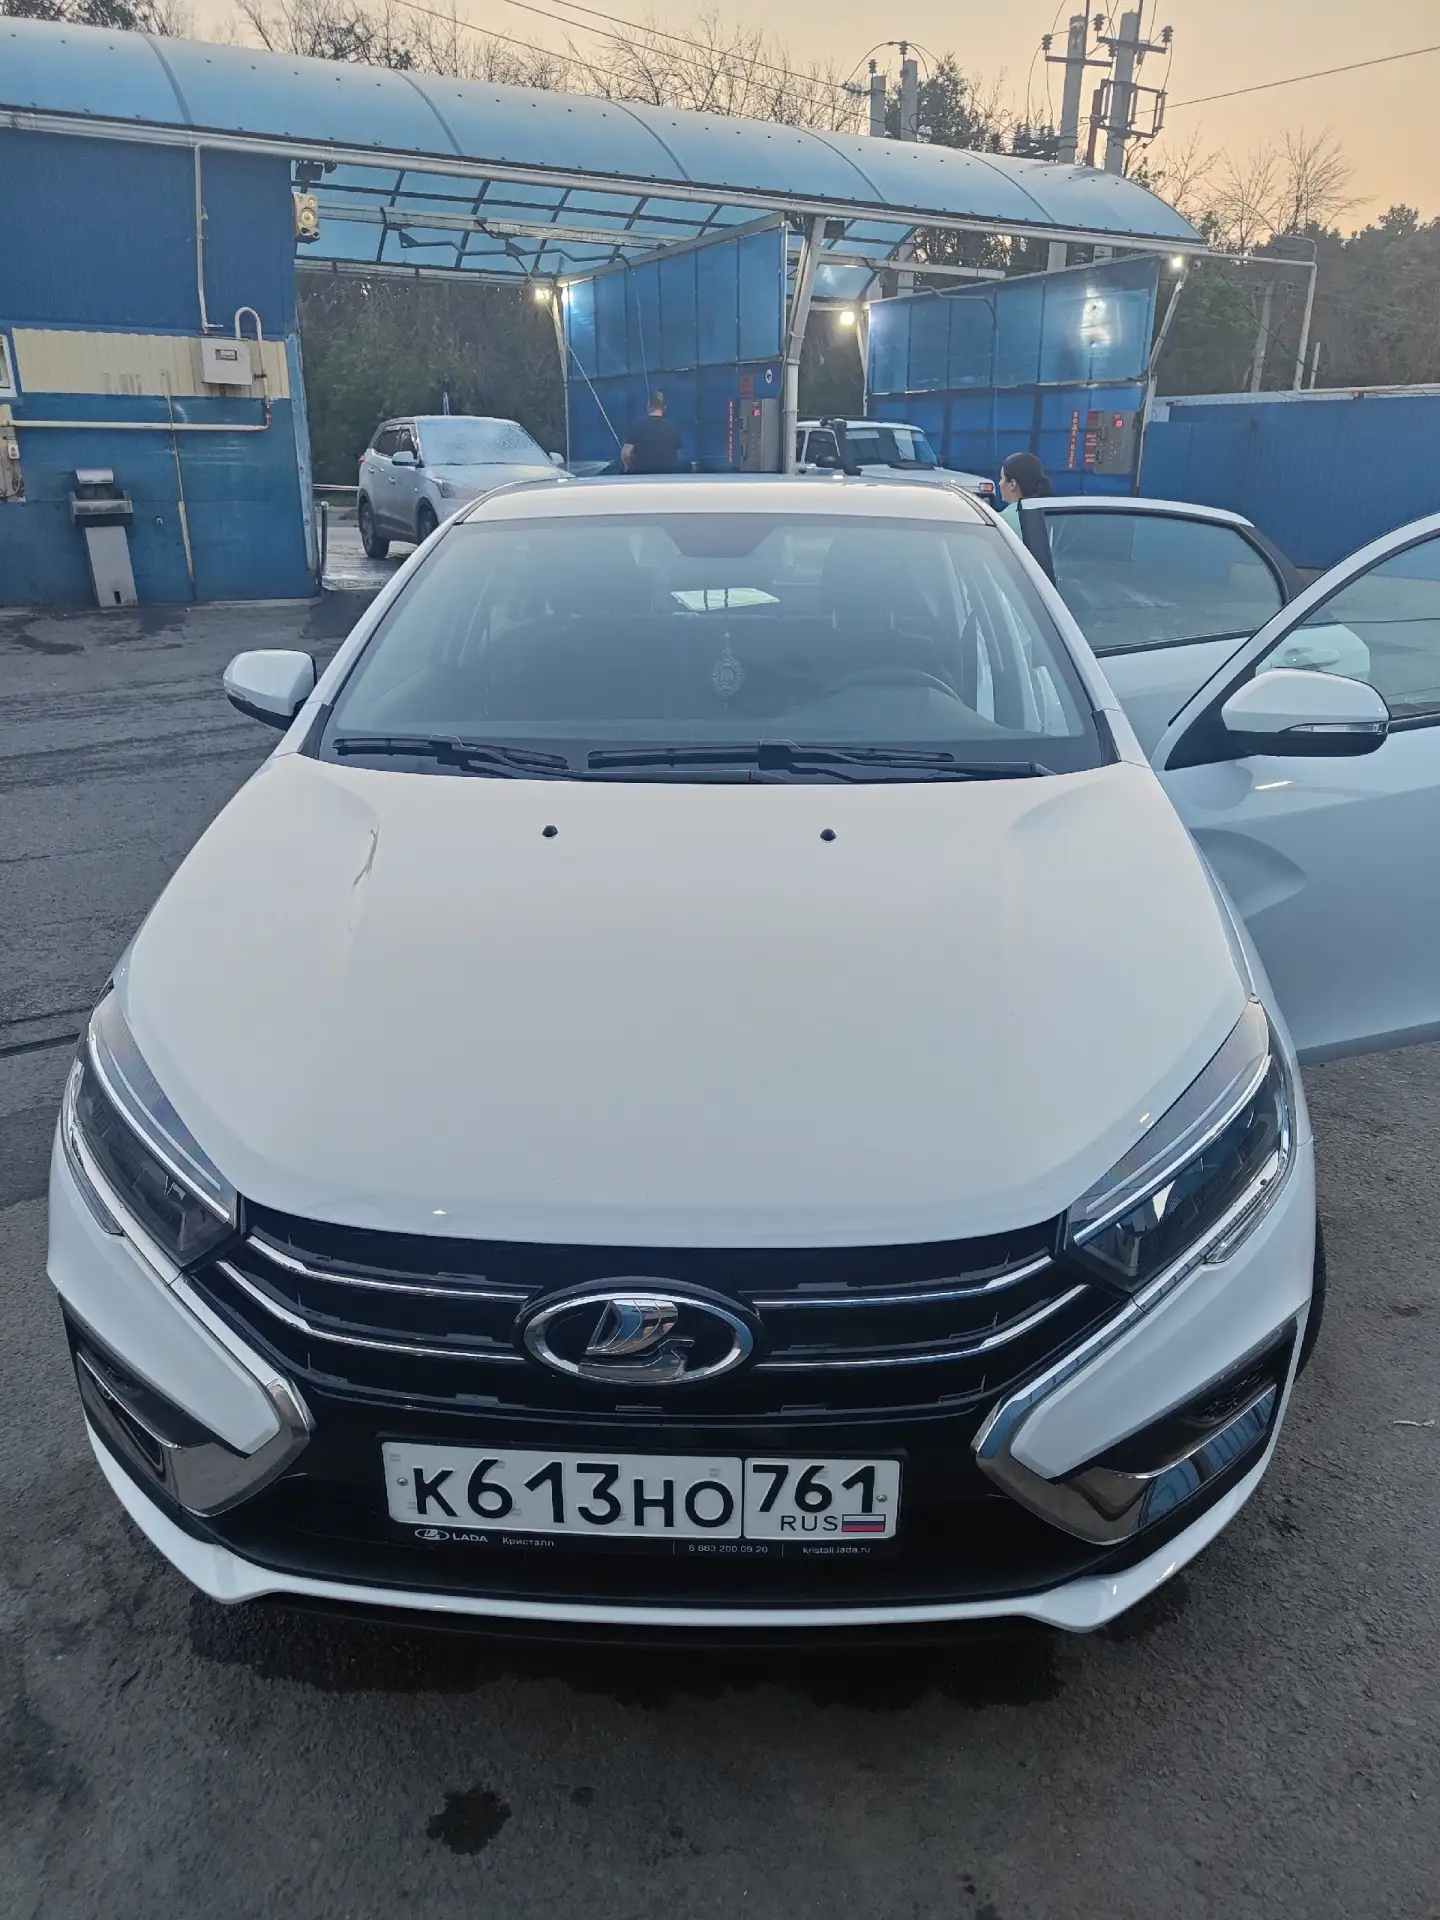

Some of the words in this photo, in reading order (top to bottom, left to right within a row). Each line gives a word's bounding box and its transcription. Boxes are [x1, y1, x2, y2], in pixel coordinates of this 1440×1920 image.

[412, 1458, 734, 1529] К613НО
[752, 1464, 876, 1514] 761
[780, 1515, 839, 1532] RUS
[452, 1532, 489, 1544] LADA
[502, 1536, 556, 1547] Кристалл
[719, 1544, 738, 1553] 200
[740, 1545, 753, 1553] 09
[755, 1545, 768, 1553] 20
[803, 1545, 871, 1555] kristall.lada.ru
